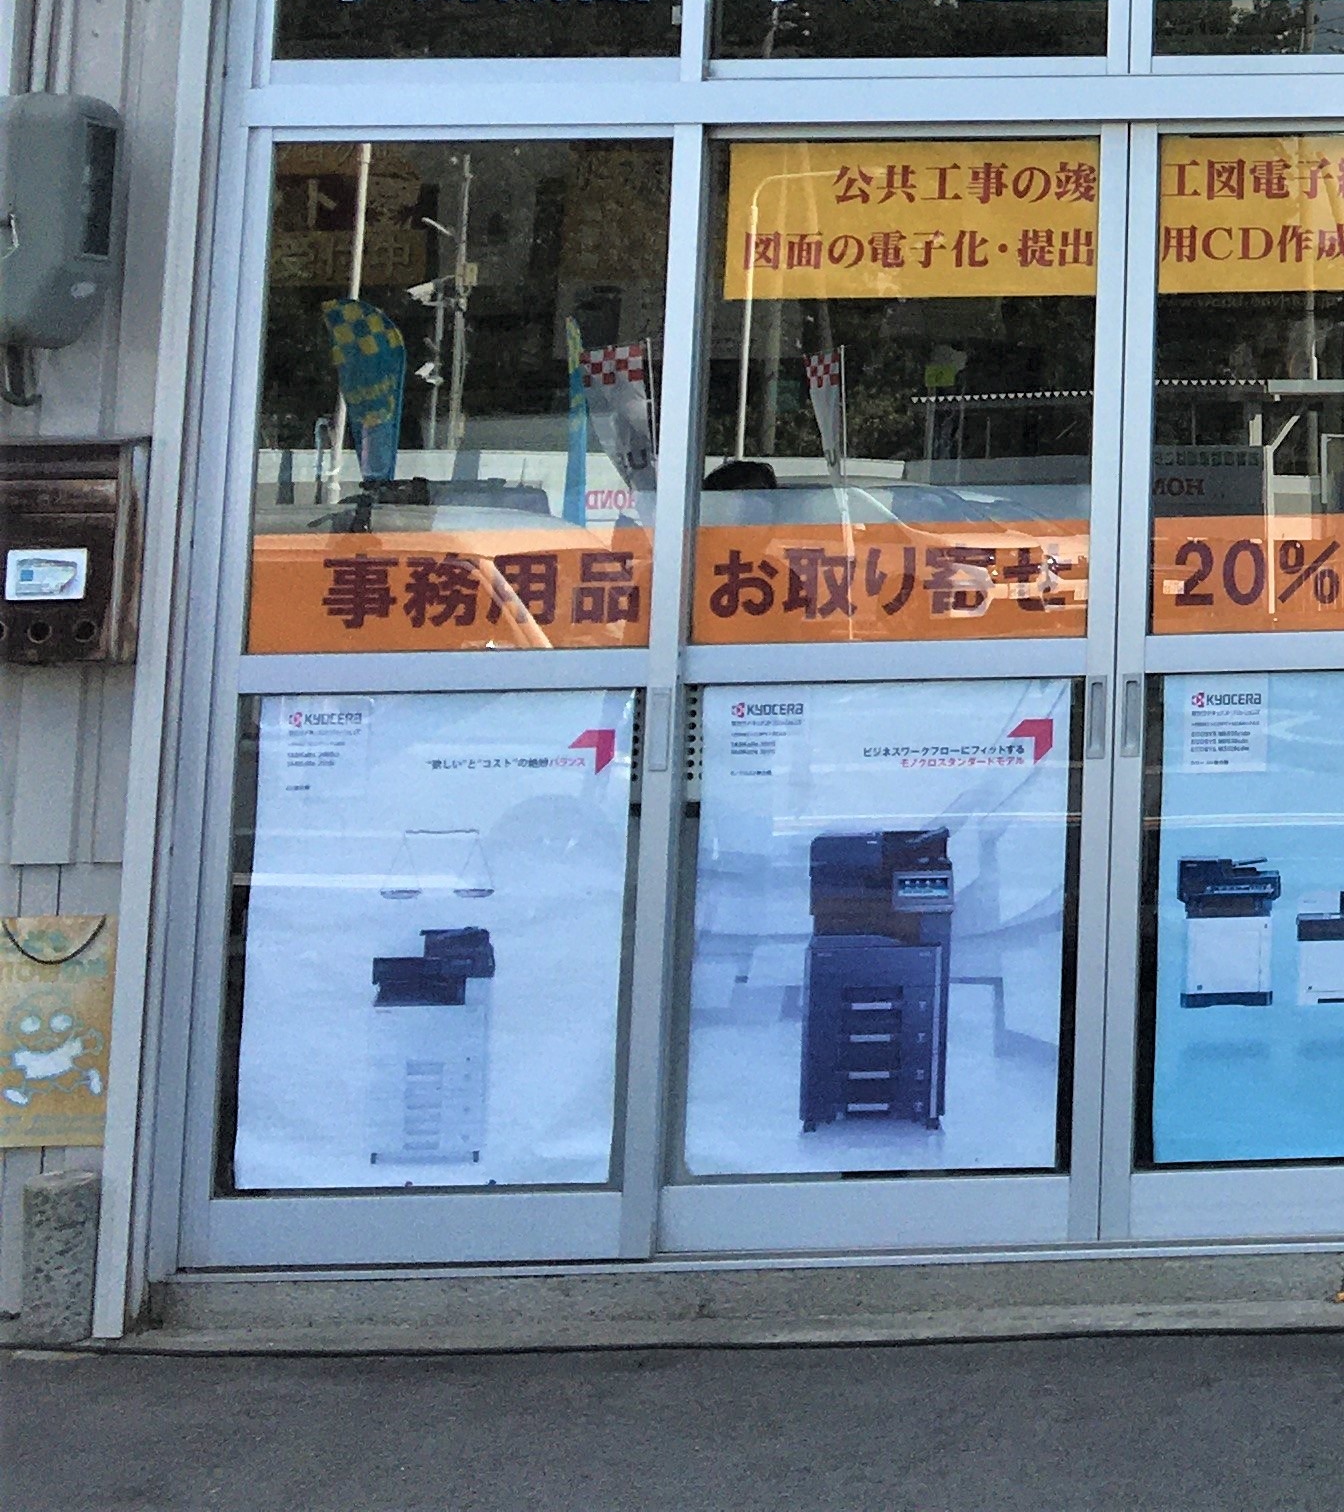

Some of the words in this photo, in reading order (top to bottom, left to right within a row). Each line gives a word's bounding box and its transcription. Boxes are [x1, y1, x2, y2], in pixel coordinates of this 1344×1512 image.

[832, 161, 1097, 205] 公共工事の竣
[743, 228, 1096, 270] 図面の電子化・提出
[322, 550, 642, 628] 事務用品
[746, 703, 804, 716] KYOCERA
[1206, 693, 1262, 706] KYOCERA
[304, 712, 363, 725] KYOCERA
